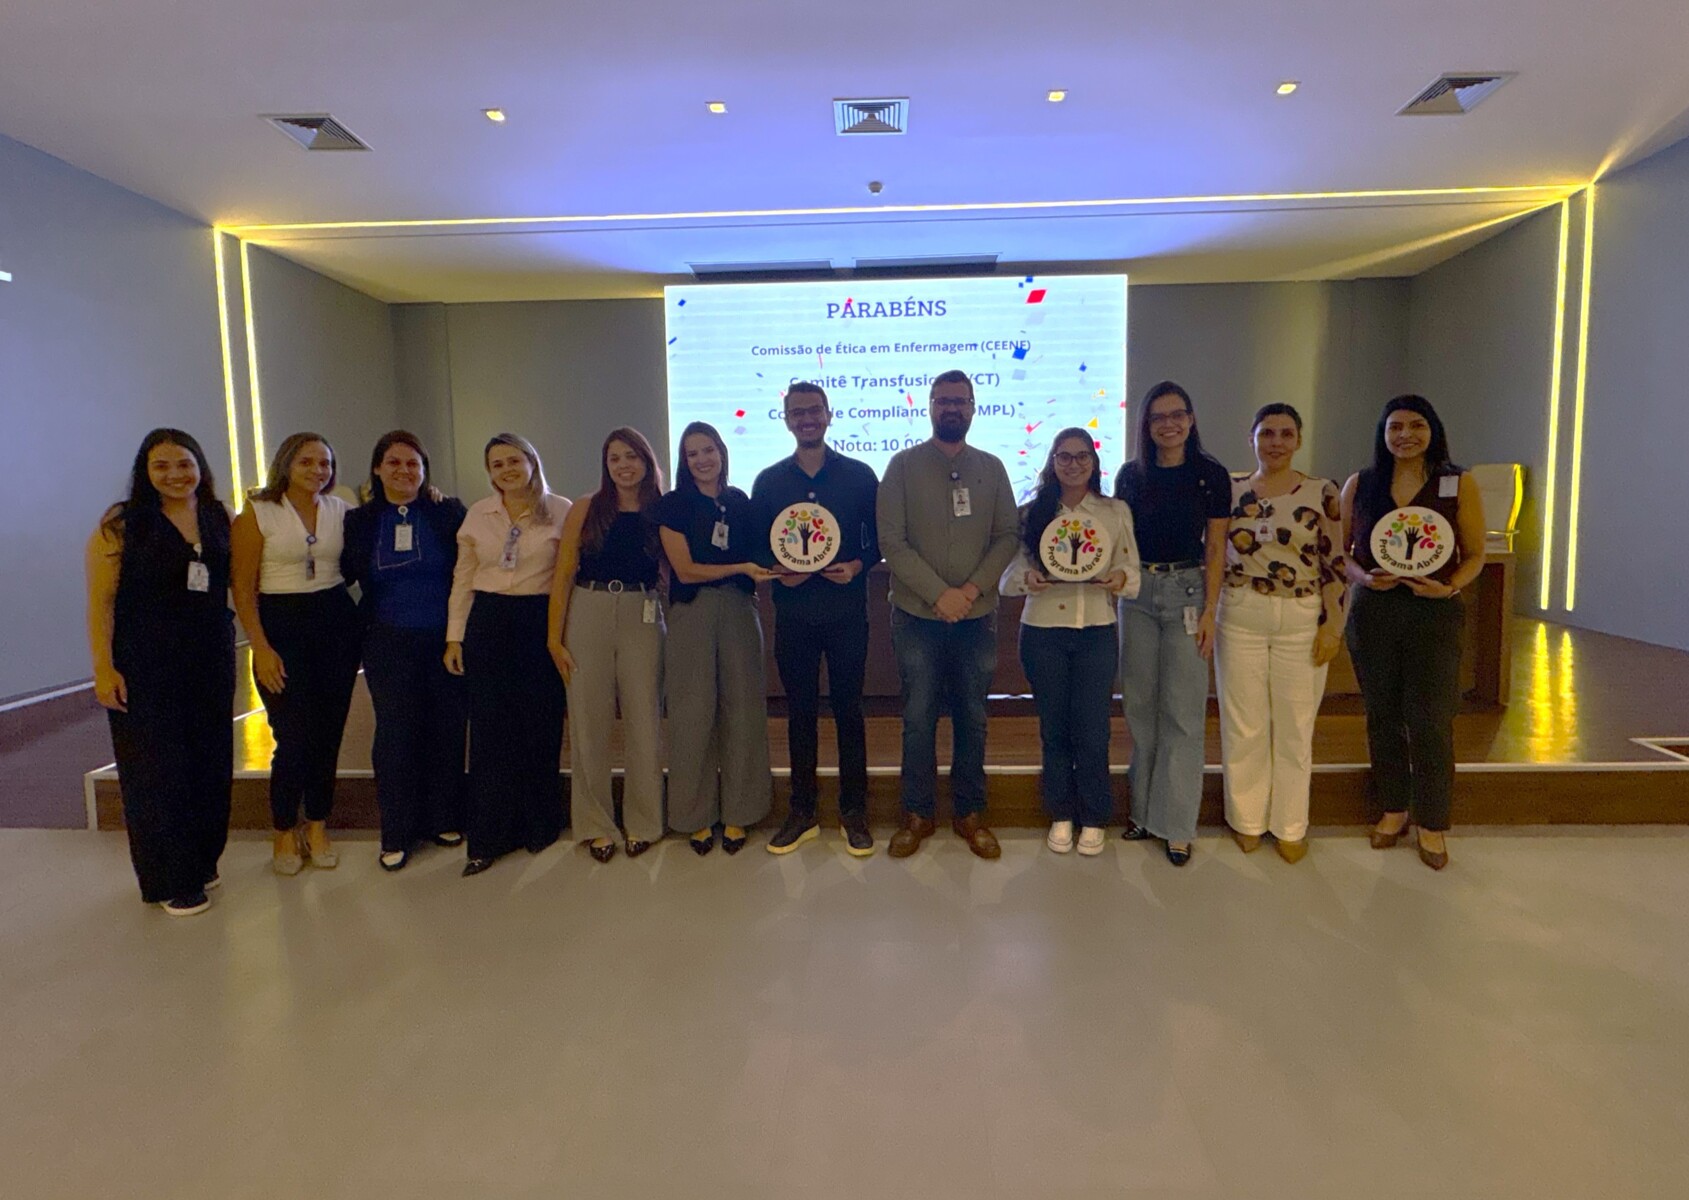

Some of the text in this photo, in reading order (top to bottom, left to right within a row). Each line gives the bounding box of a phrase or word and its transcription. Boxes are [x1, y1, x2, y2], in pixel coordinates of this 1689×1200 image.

[826, 295, 947, 319] PARABÉNS
[751, 340, 1031, 356] Comissão de Ética em Enfermagem (CEENF)
[789, 375, 847, 388] Cmitê
[849, 405, 927, 421] Complianc
[833, 439, 877, 451] Nota:
[778, 536, 833, 566] Programa Abrace
[1047, 545, 1103, 575] Programa Abrace
[1379, 538, 1444, 571] Programa Abrace
